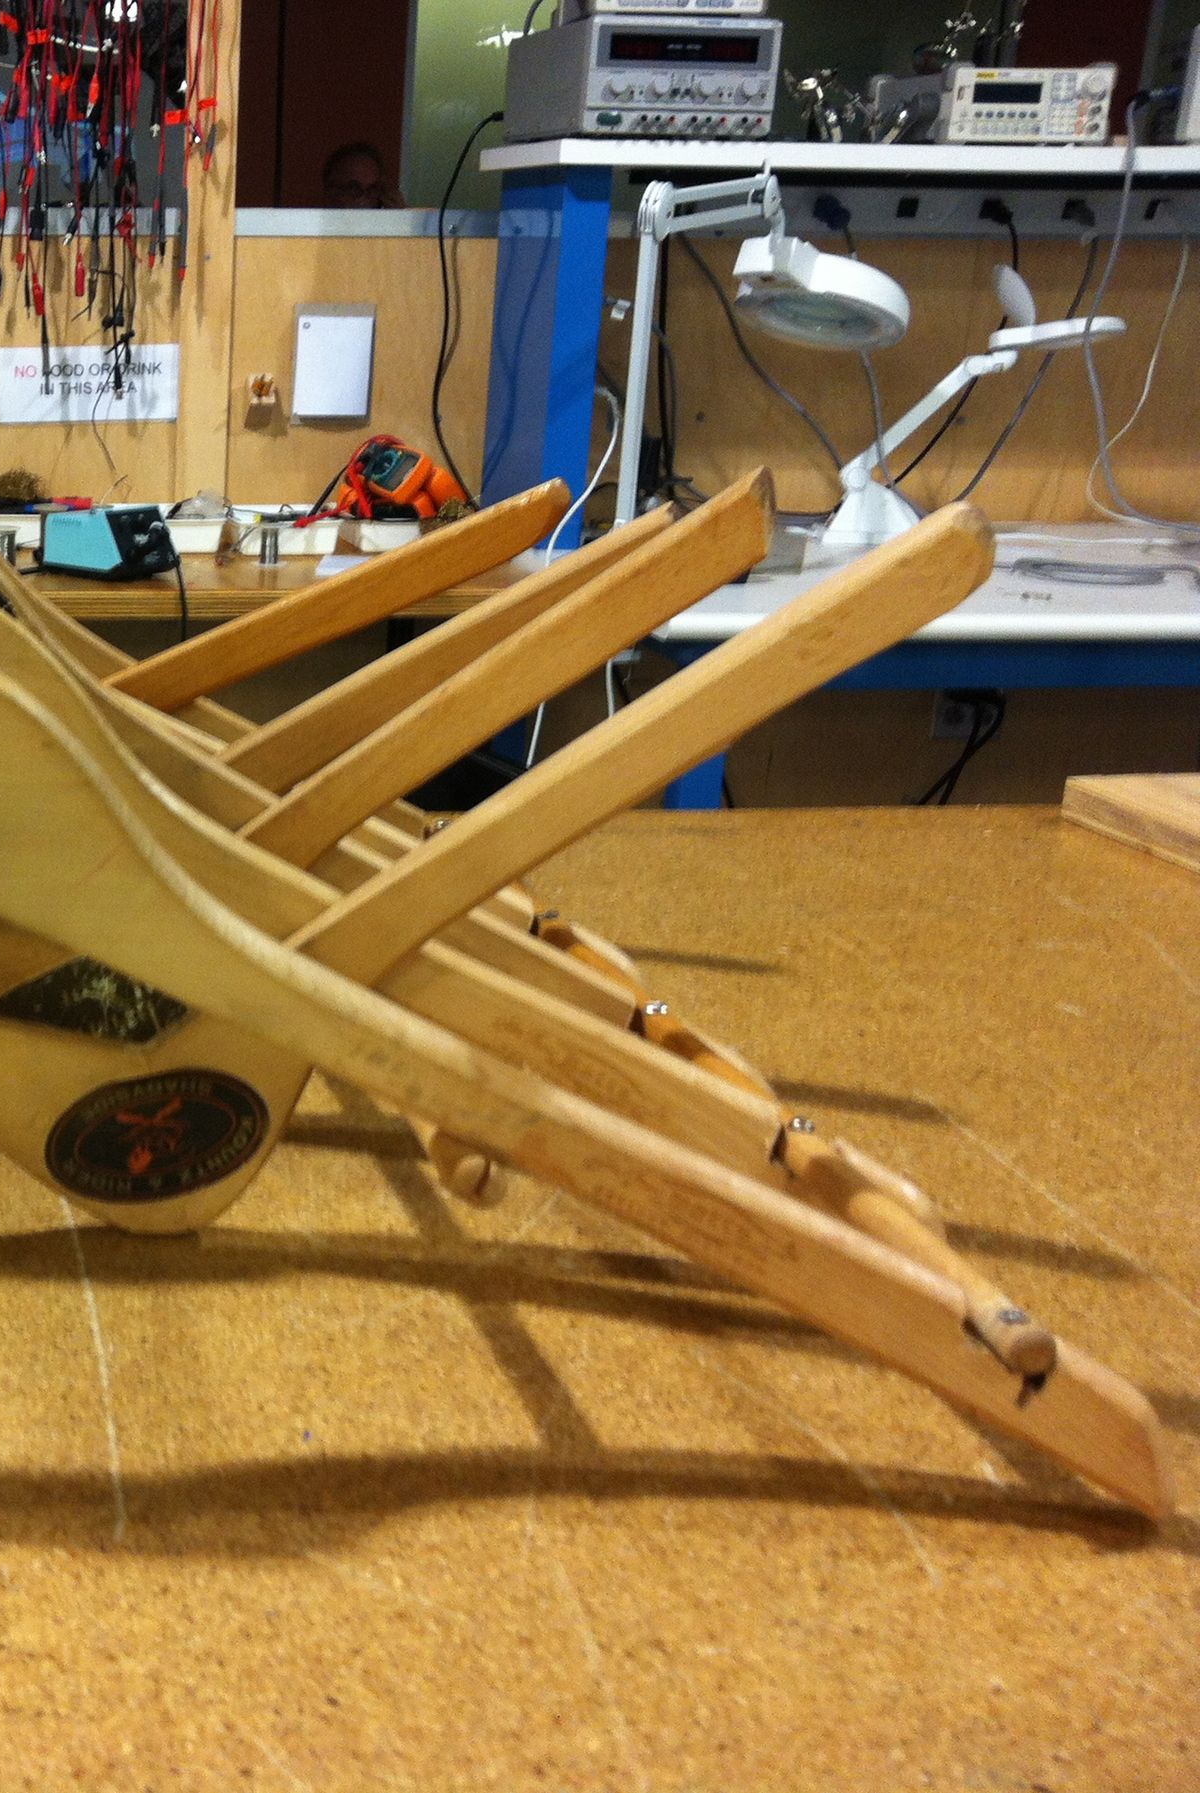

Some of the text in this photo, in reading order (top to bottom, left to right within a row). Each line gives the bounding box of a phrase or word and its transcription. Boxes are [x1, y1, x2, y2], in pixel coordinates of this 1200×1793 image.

[14, 365, 37, 378] NO
[42, 363, 84, 377] OOD
[89, 363, 112, 376] OR
[59, 382, 92, 395] THIS
